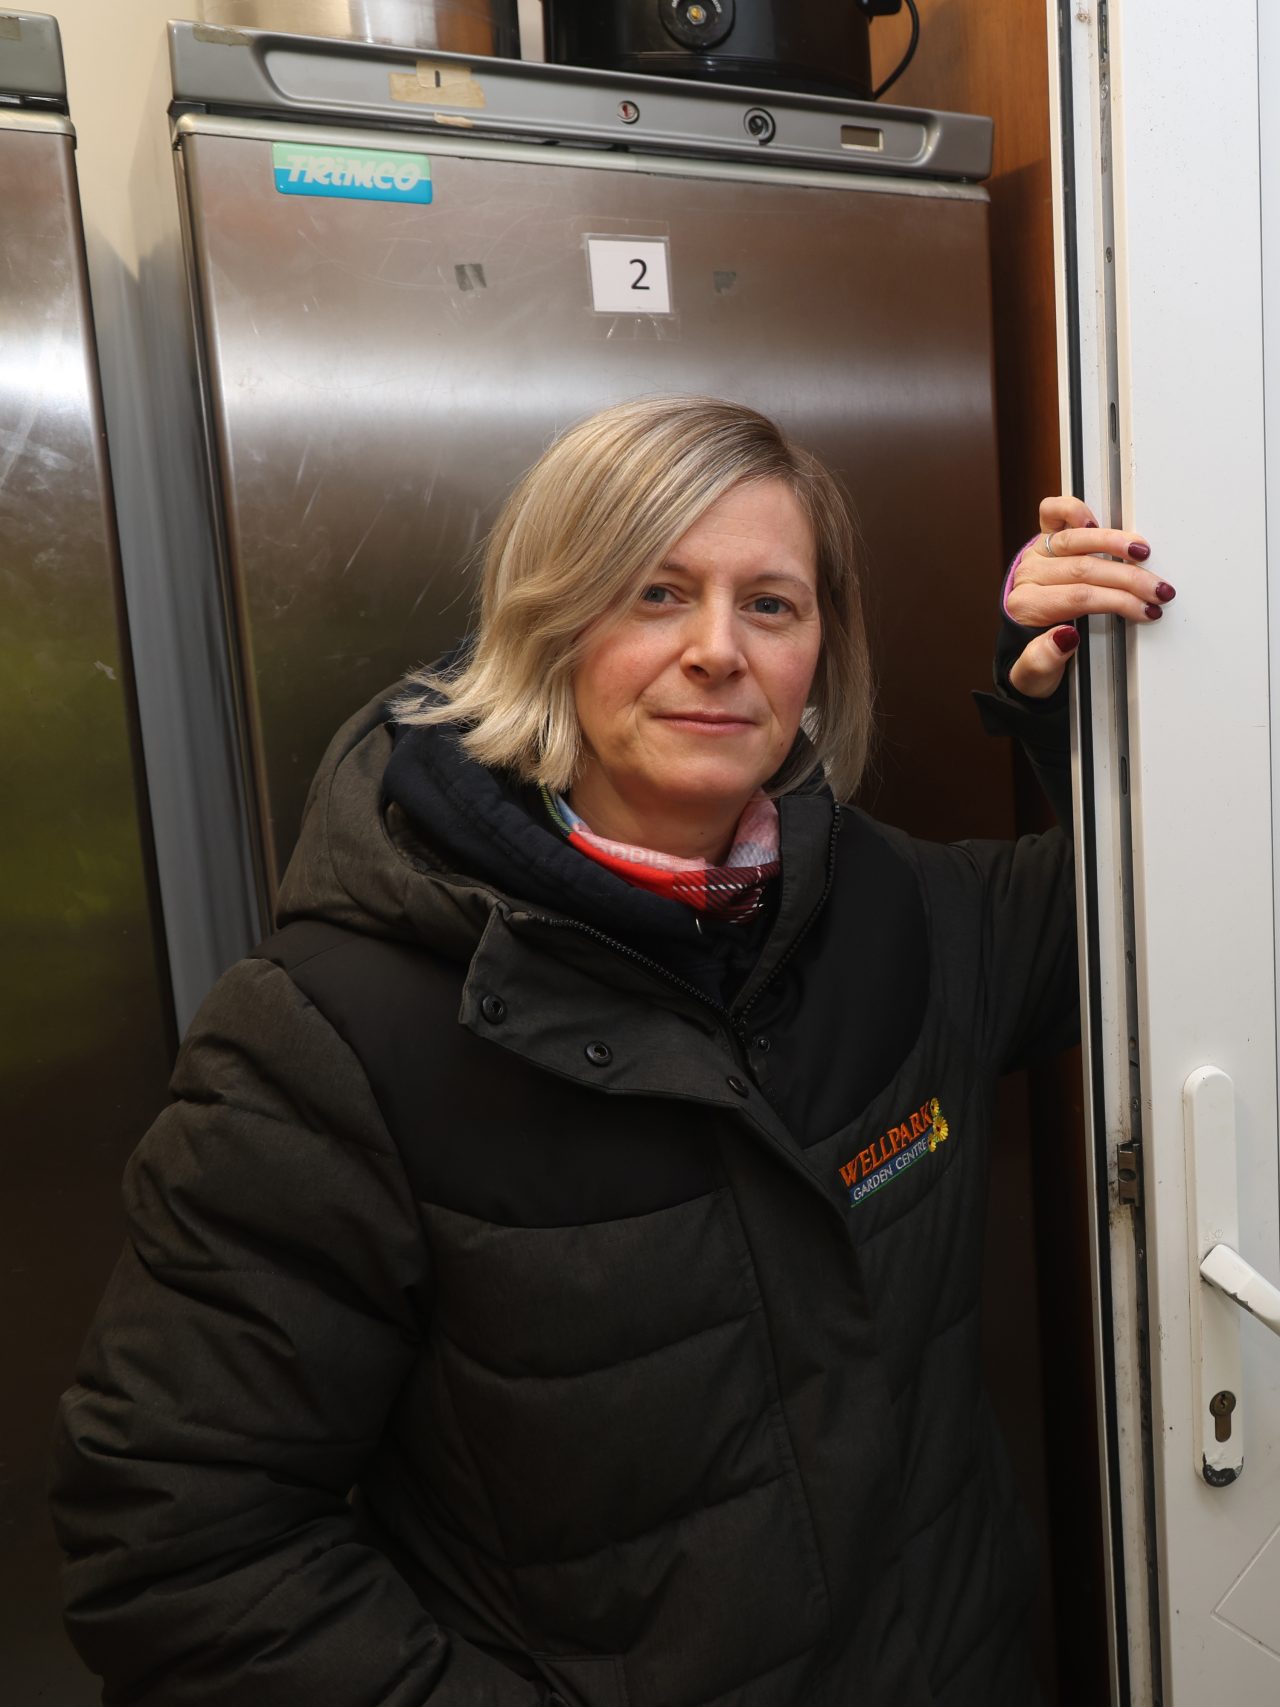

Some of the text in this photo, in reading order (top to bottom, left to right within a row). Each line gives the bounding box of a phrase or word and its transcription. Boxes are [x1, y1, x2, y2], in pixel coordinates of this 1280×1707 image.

[629, 258, 650, 290] 2
[838, 1101, 933, 1188] WELLPARK
[853, 1138, 928, 1201] GARDEN CENTRE
